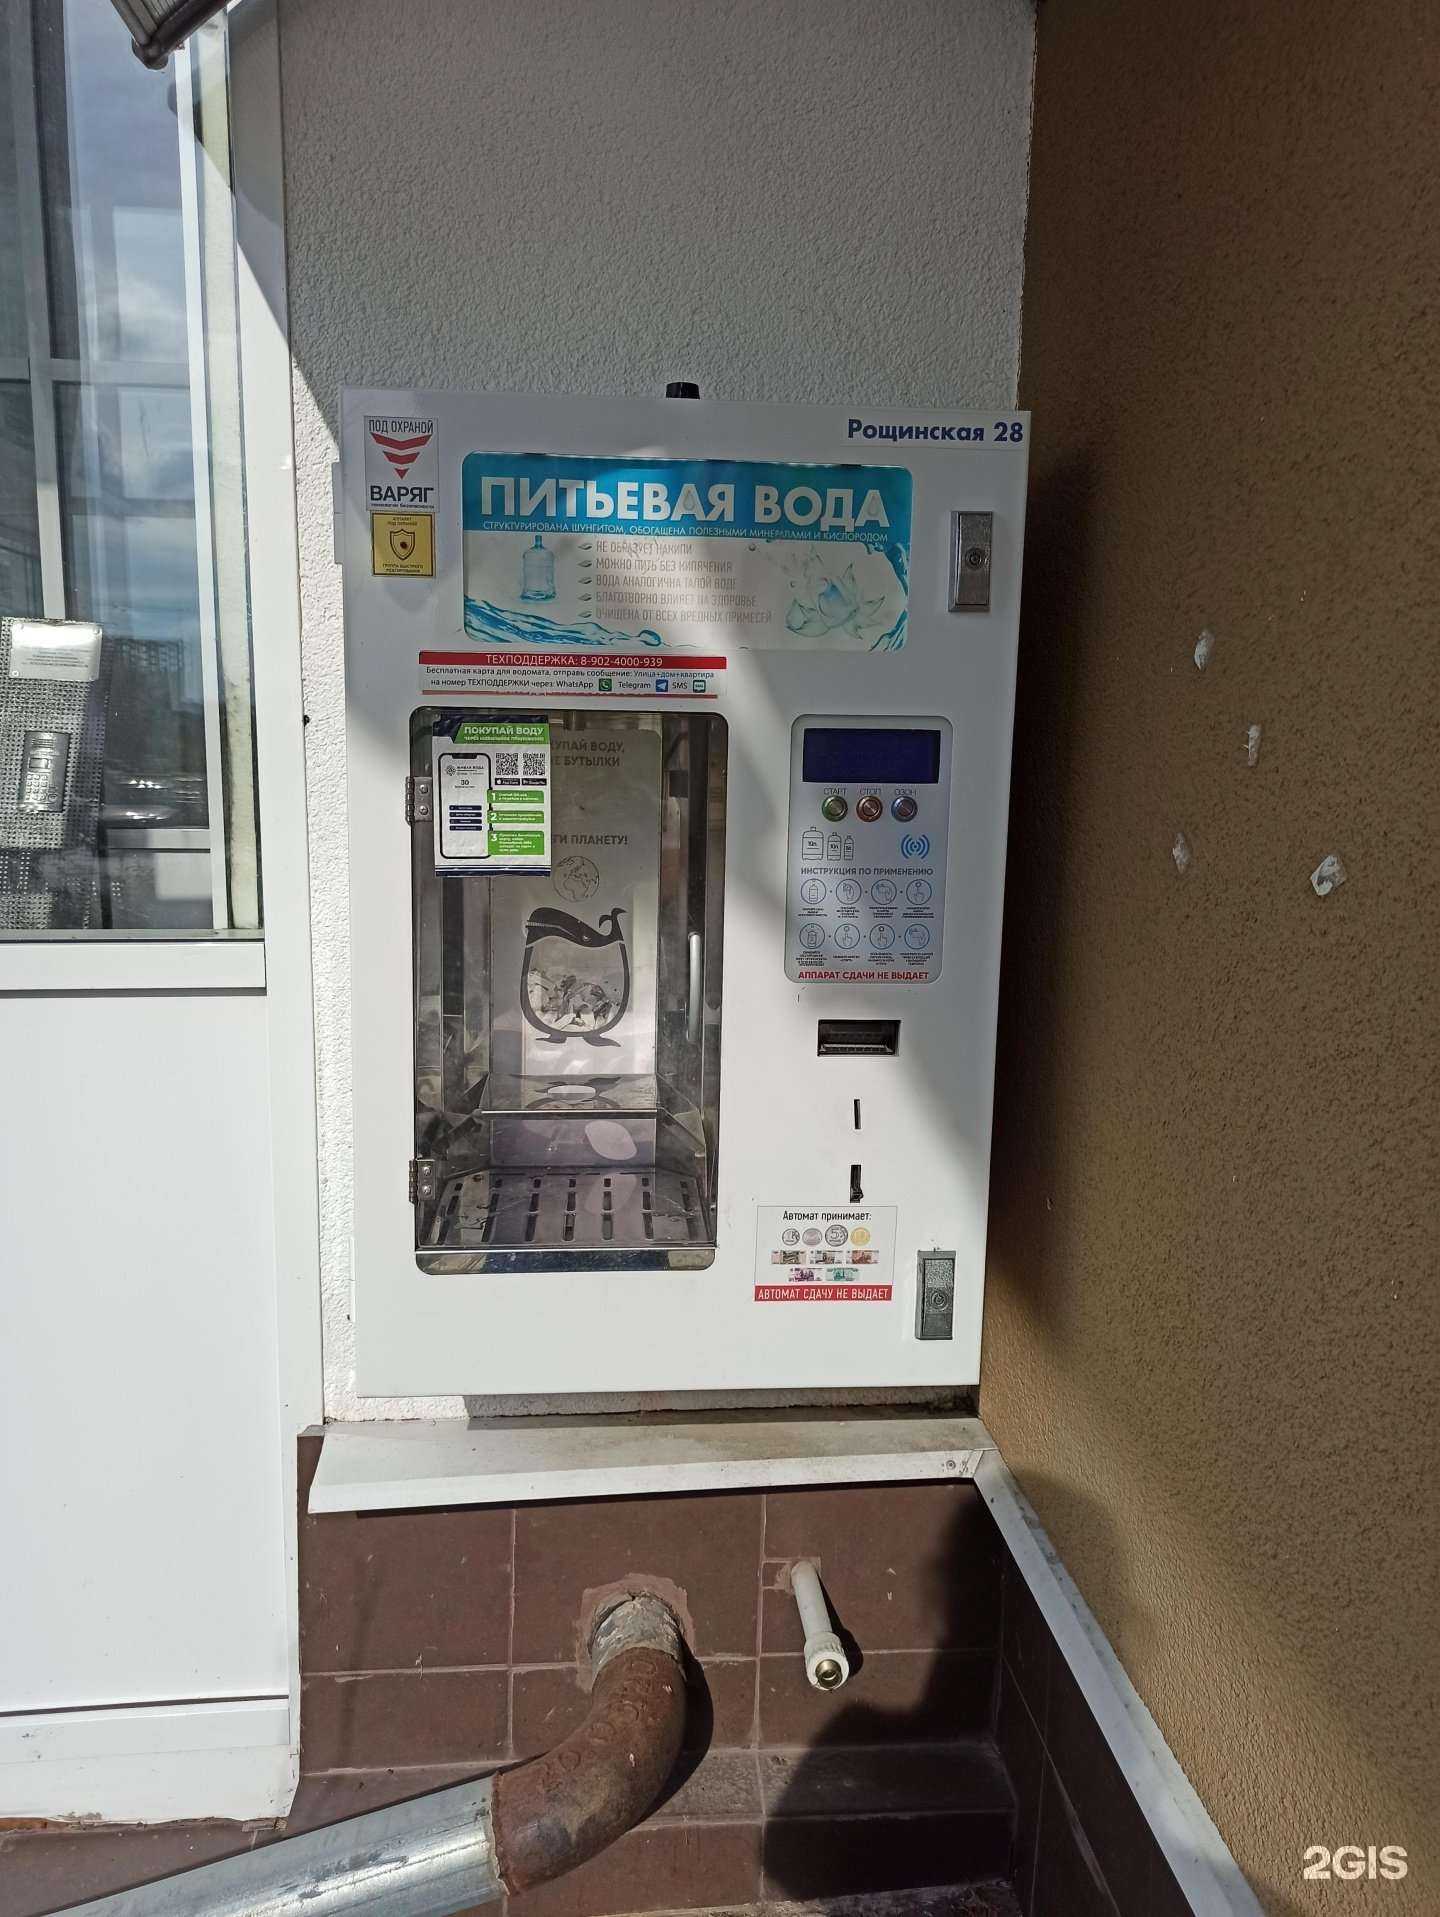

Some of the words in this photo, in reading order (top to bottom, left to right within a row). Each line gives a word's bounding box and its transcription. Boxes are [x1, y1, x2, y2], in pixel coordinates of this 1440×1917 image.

[369, 420, 389, 434] ПОД
[391, 420, 434, 434] ОХРАНОЙ
[848, 419, 984, 442] Рощинская
[993, 422, 1023, 442] 28
[370, 485, 434, 503] ВАРЯГ
[481, 476, 735, 522] ПИТЬЕВАЯ
[755, 485, 890, 532] ВОДА
[482, 520, 569, 532] СТРУКТУРИРОВАНА
[572, 523, 626, 535] ШУНГИТОМ,
[629, 525, 687, 536] ОБОГАЩЕНА
[688, 527, 747, 537] ПОЛЕЗНЫМИ
[750, 529, 811, 540] МИНЕРАЛАМИ
[813, 532, 820, 540] И
[824, 532, 888, 543] КИСЛОРОДОМ
[596, 541, 608, 552] НЕ
[596, 558, 632, 570] МОЖНО
[660, 560, 676, 572] БЕЗ
[596, 574, 620, 587] ВОДА
[623, 575, 681, 588] АНАЛОГИЧНА
[596, 592, 658, 604] БЛАГОТВОРНО
[712, 594, 757, 608] ЗДОРОВЬЕ
[596, 608, 640, 621] ОЧИЩЕНА
[642, 610, 656, 621] ОТ
[656, 610, 679, 622] ВСЕХ
[486, 654, 578, 666] ТЕХПОДДЕРЖКА:
[580, 656, 662, 667] 8-902-4000-939
[426, 666, 471, 674] Бесплатная
[472, 668, 495, 676] карта
[496, 668, 511, 676] для
[553, 670, 585, 678] отправь
[587, 670, 632, 678] сообщение:
[633, 671, 714, 680] Улица+дом+квартира
[467, 679, 530, 687] ТЕХПОДДЕРЖКИ
[556, 680, 593, 689] WhatsApp
[618, 681, 651, 689] Telegram
[672, 681, 688, 689] SMS
[464, 726, 514, 735] ПОКУПАЙ
[516, 727, 544, 736] ВОДУ
[551, 739, 587, 752] УПАЙ
[590, 740, 625, 754] ВОДУ,
[564, 756, 620, 767] БУТЫЛКИ
[823, 788, 848, 796] СТАРТ
[859, 788, 881, 796] СТОП
[490, 833, 497, 841] 3
[571, 834, 628, 845] ПЛАНЕТУ!
[801, 868, 857, 877] ИНСТРУКЦИЯ
[873, 868, 934, 876] ПРИМЕНЕНИЮ
[798, 971, 840, 979] АППАРАТ
[842, 972, 875, 981] СДАЧИ
[877, 972, 889, 980] НЕ
[891, 972, 929, 981] ВЫДАЕТ
[783, 1210, 818, 1221] Автомат
[821, 1212, 872, 1222] принимает:
[758, 1288, 801, 1300] АВТОМАТ
[803, 1288, 833, 1300] СДАЧУ
[836, 1288, 848, 1299] НЕ
[851, 1288, 889, 1300] ВЫДАЕТ
